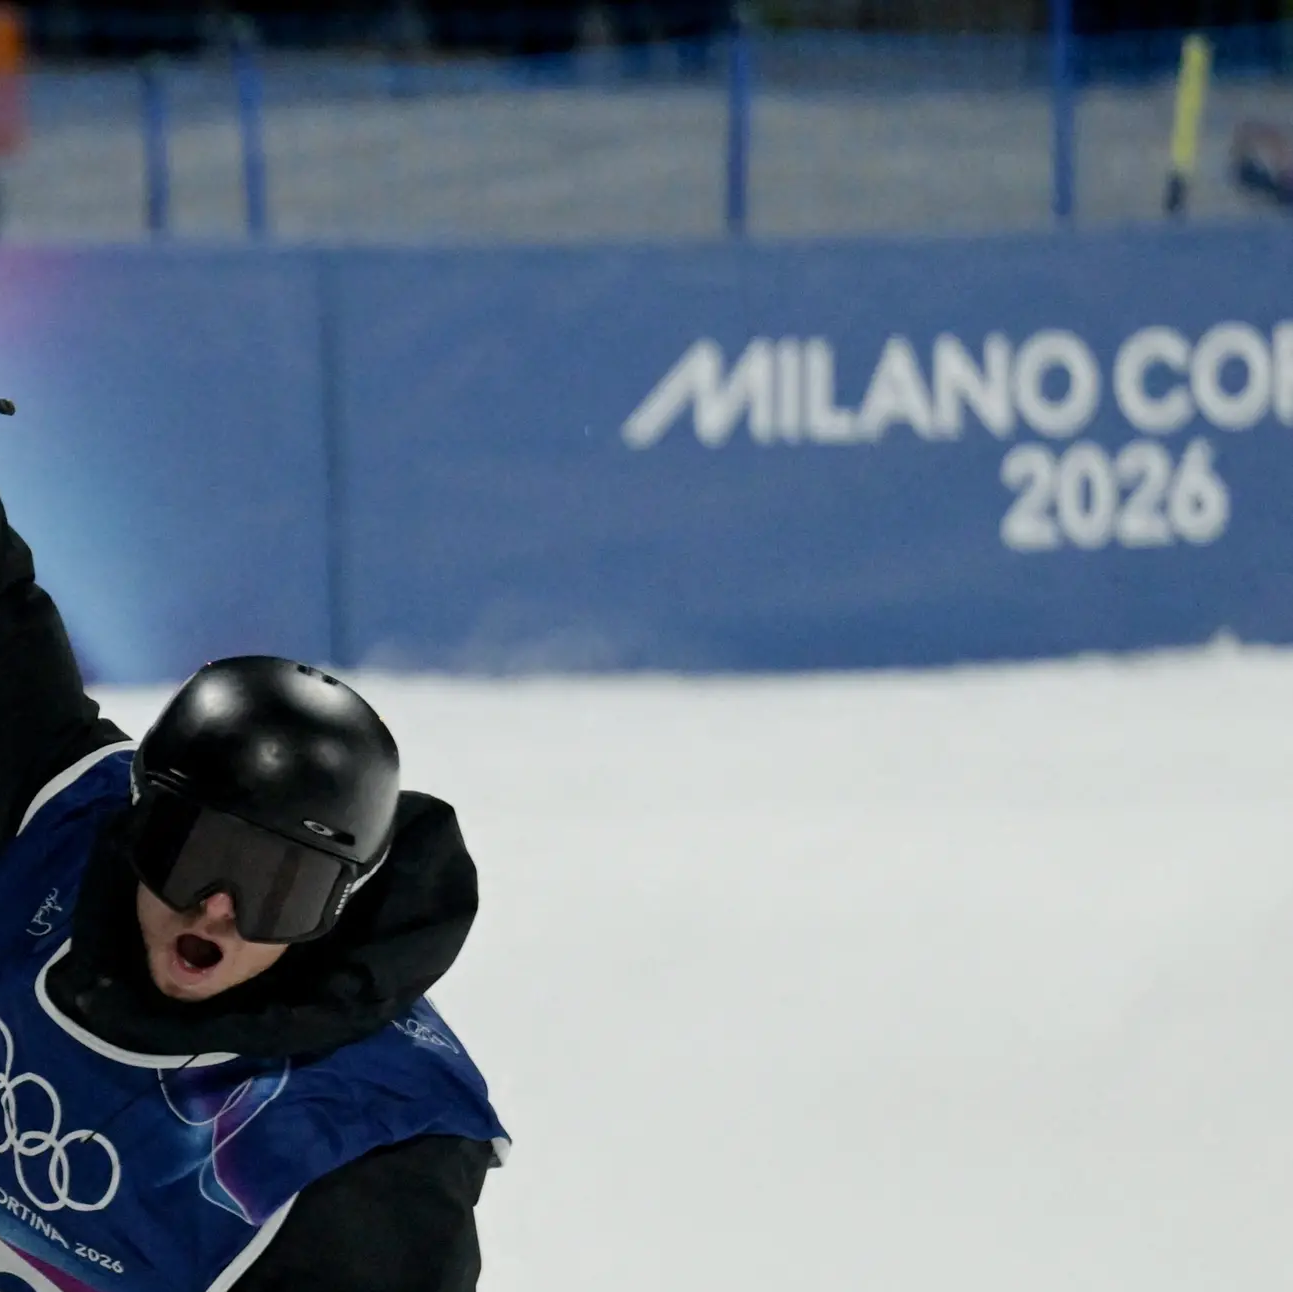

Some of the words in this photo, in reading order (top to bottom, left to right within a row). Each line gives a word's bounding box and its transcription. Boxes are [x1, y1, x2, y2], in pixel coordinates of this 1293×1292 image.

[621, 328, 1101, 450] MILANO
[999, 438, 1230, 553] 2026
[74, 1242, 125, 1274] 2026
